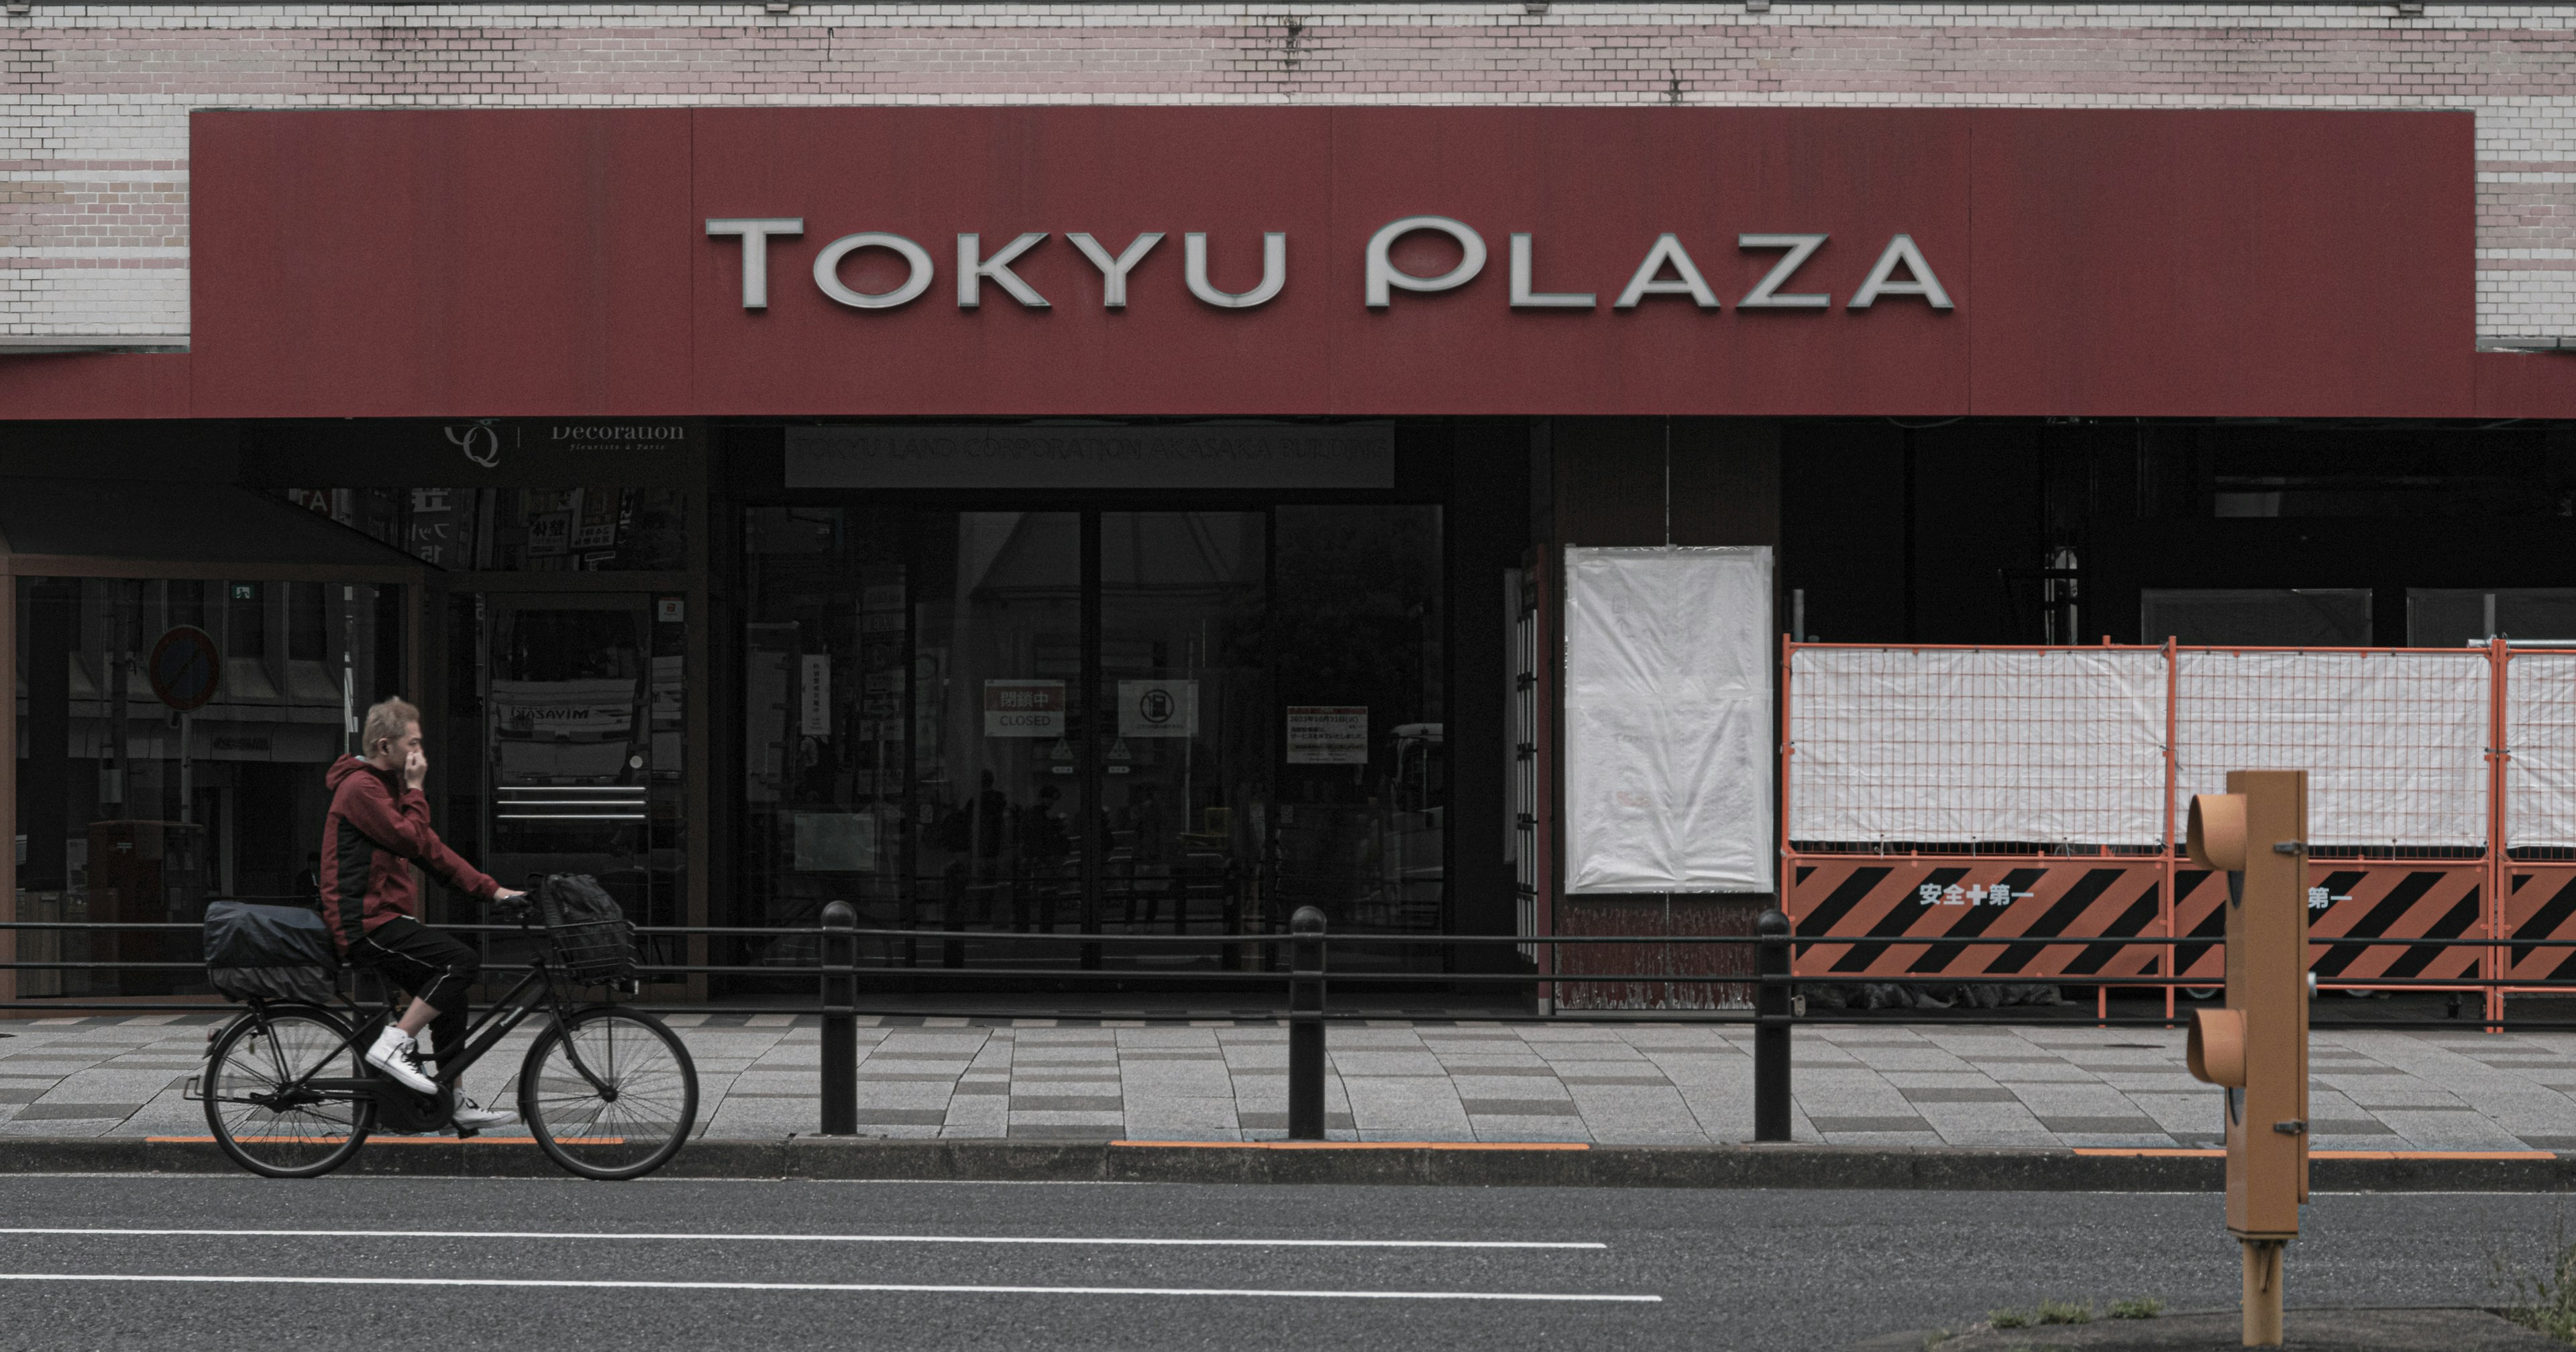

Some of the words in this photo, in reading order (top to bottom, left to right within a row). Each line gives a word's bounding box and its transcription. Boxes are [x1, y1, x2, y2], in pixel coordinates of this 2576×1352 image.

[705, 217, 1287, 308] TOKYU
[1366, 215, 1955, 308] PLAZA
[796, 439, 880, 457] TOKYU
[891, 439, 955, 458] LAND
[965, 438, 1140, 459] CORPORATION
[1148, 438, 1273, 459] AKASAKA
[1281, 438, 1387, 459] BUILDING
[1000, 690, 1049, 708] 閉鎖中
[1000, 716, 1051, 726] CLOSED
[2308, 887, 2353, 909] 第一
